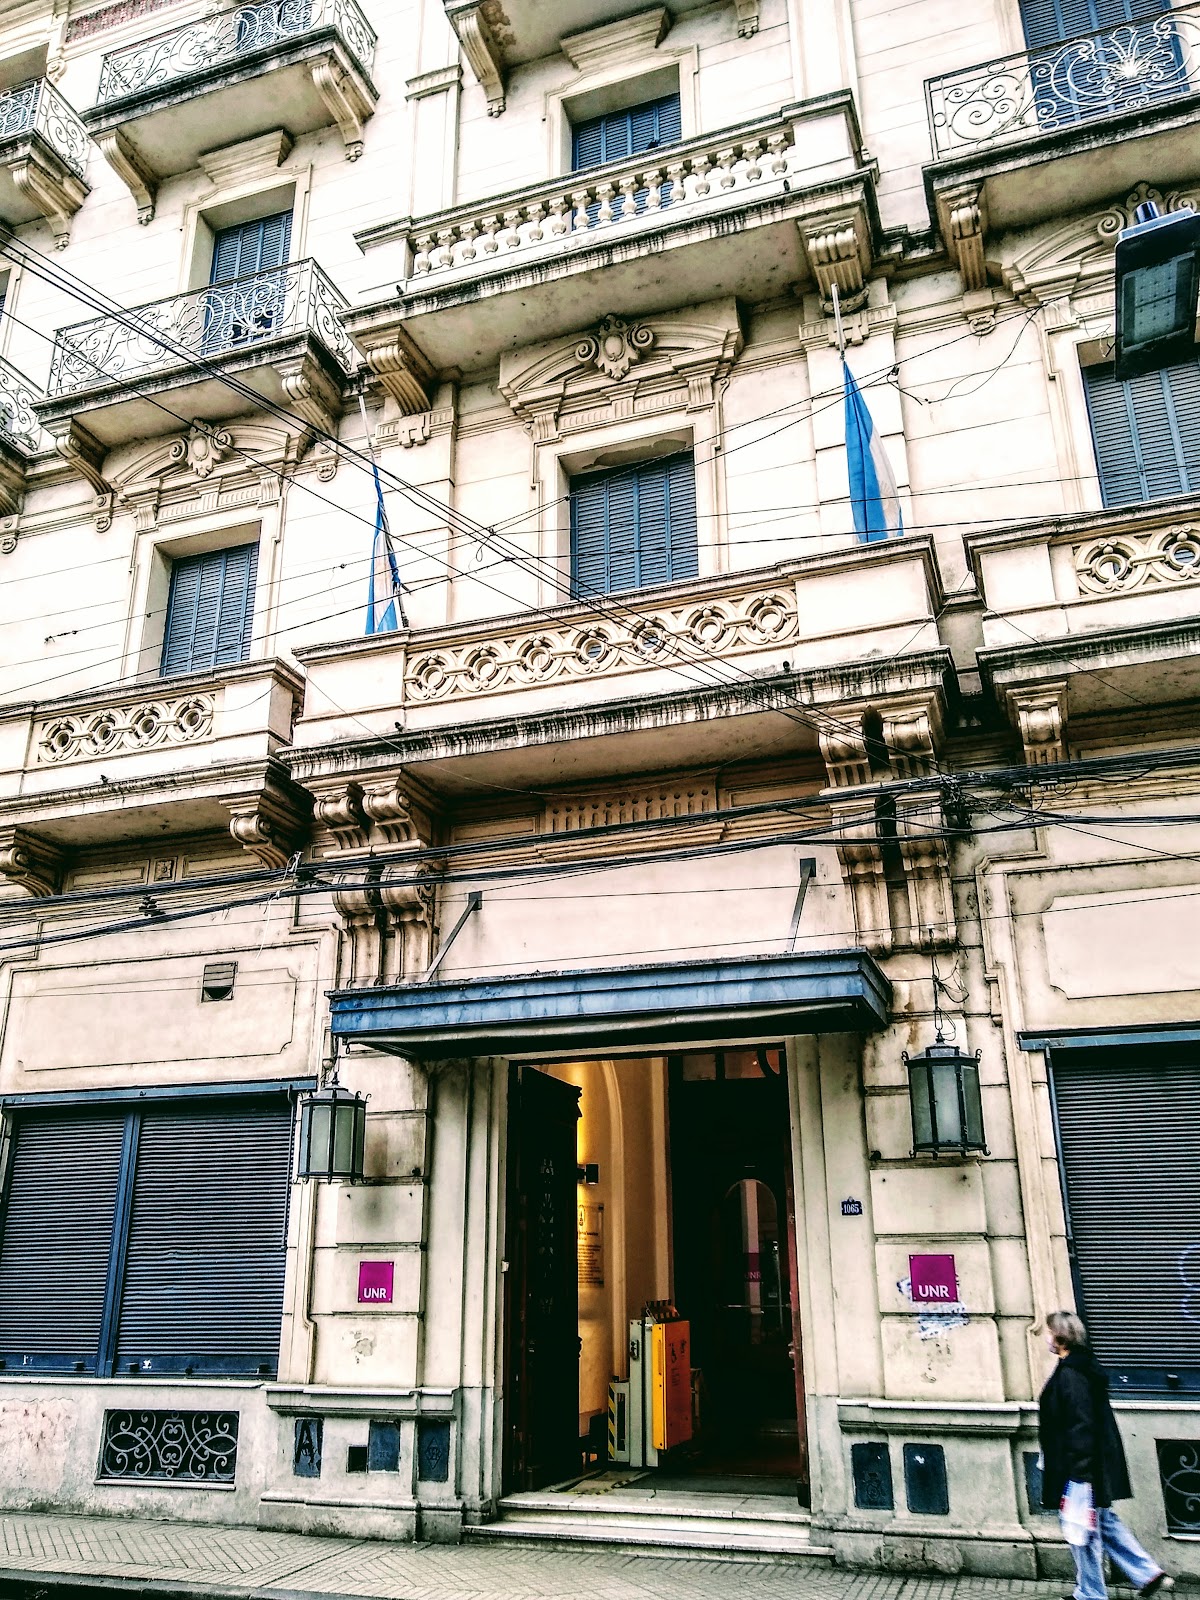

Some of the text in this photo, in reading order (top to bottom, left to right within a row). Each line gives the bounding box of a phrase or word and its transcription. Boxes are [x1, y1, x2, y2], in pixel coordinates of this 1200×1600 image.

[844, 1203, 860, 1214] 1065
[363, 1287, 387, 1299] UNR
[918, 1284, 950, 1298] UNR
